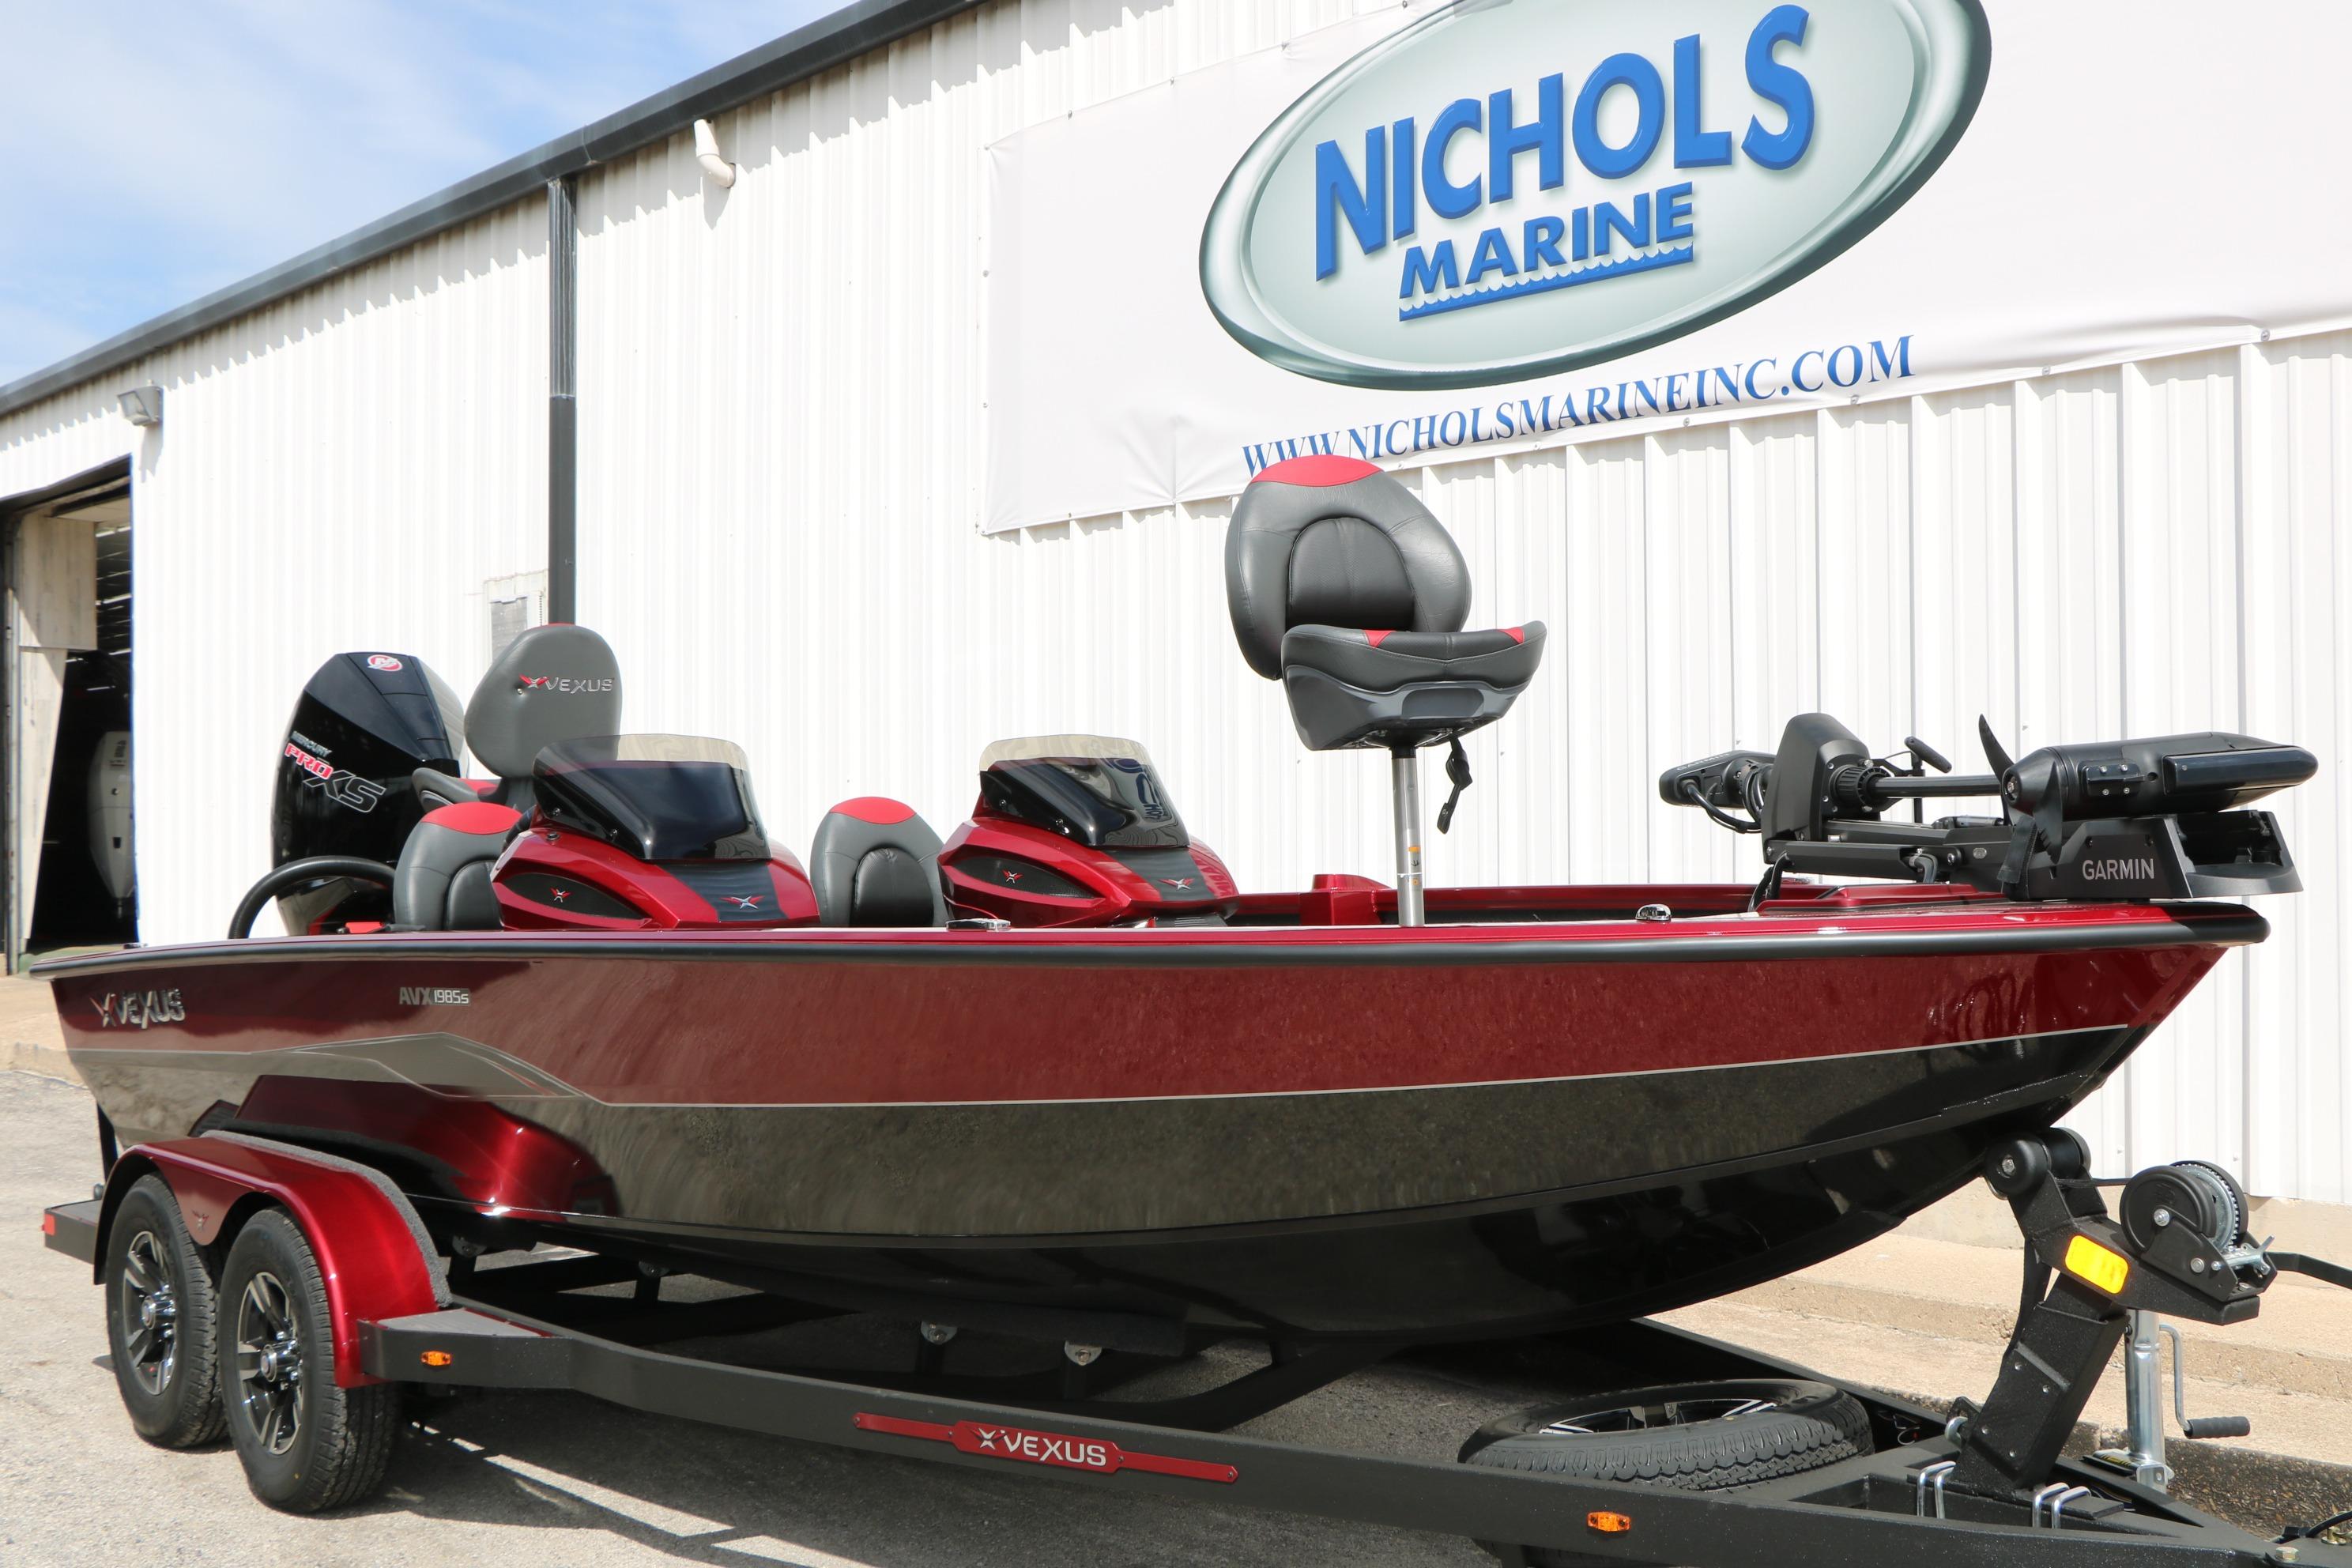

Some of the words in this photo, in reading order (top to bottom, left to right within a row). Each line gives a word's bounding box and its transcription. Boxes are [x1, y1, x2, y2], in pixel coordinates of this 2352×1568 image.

[1315, 3, 1816, 281] NICHOLS
[1398, 181, 1695, 300] MARINE
[1242, 335, 1917, 478] WWWNICHOLSMARINEINC.COM
[545, 677, 615, 694] VEXUS
[284, 742, 334, 780] PRO
[302, 769, 387, 813] XS
[2082, 858, 2155, 880] GARMIN
[115, 989, 186, 1029] VEXUS
[1001, 1428, 1107, 1468] VEXUS
